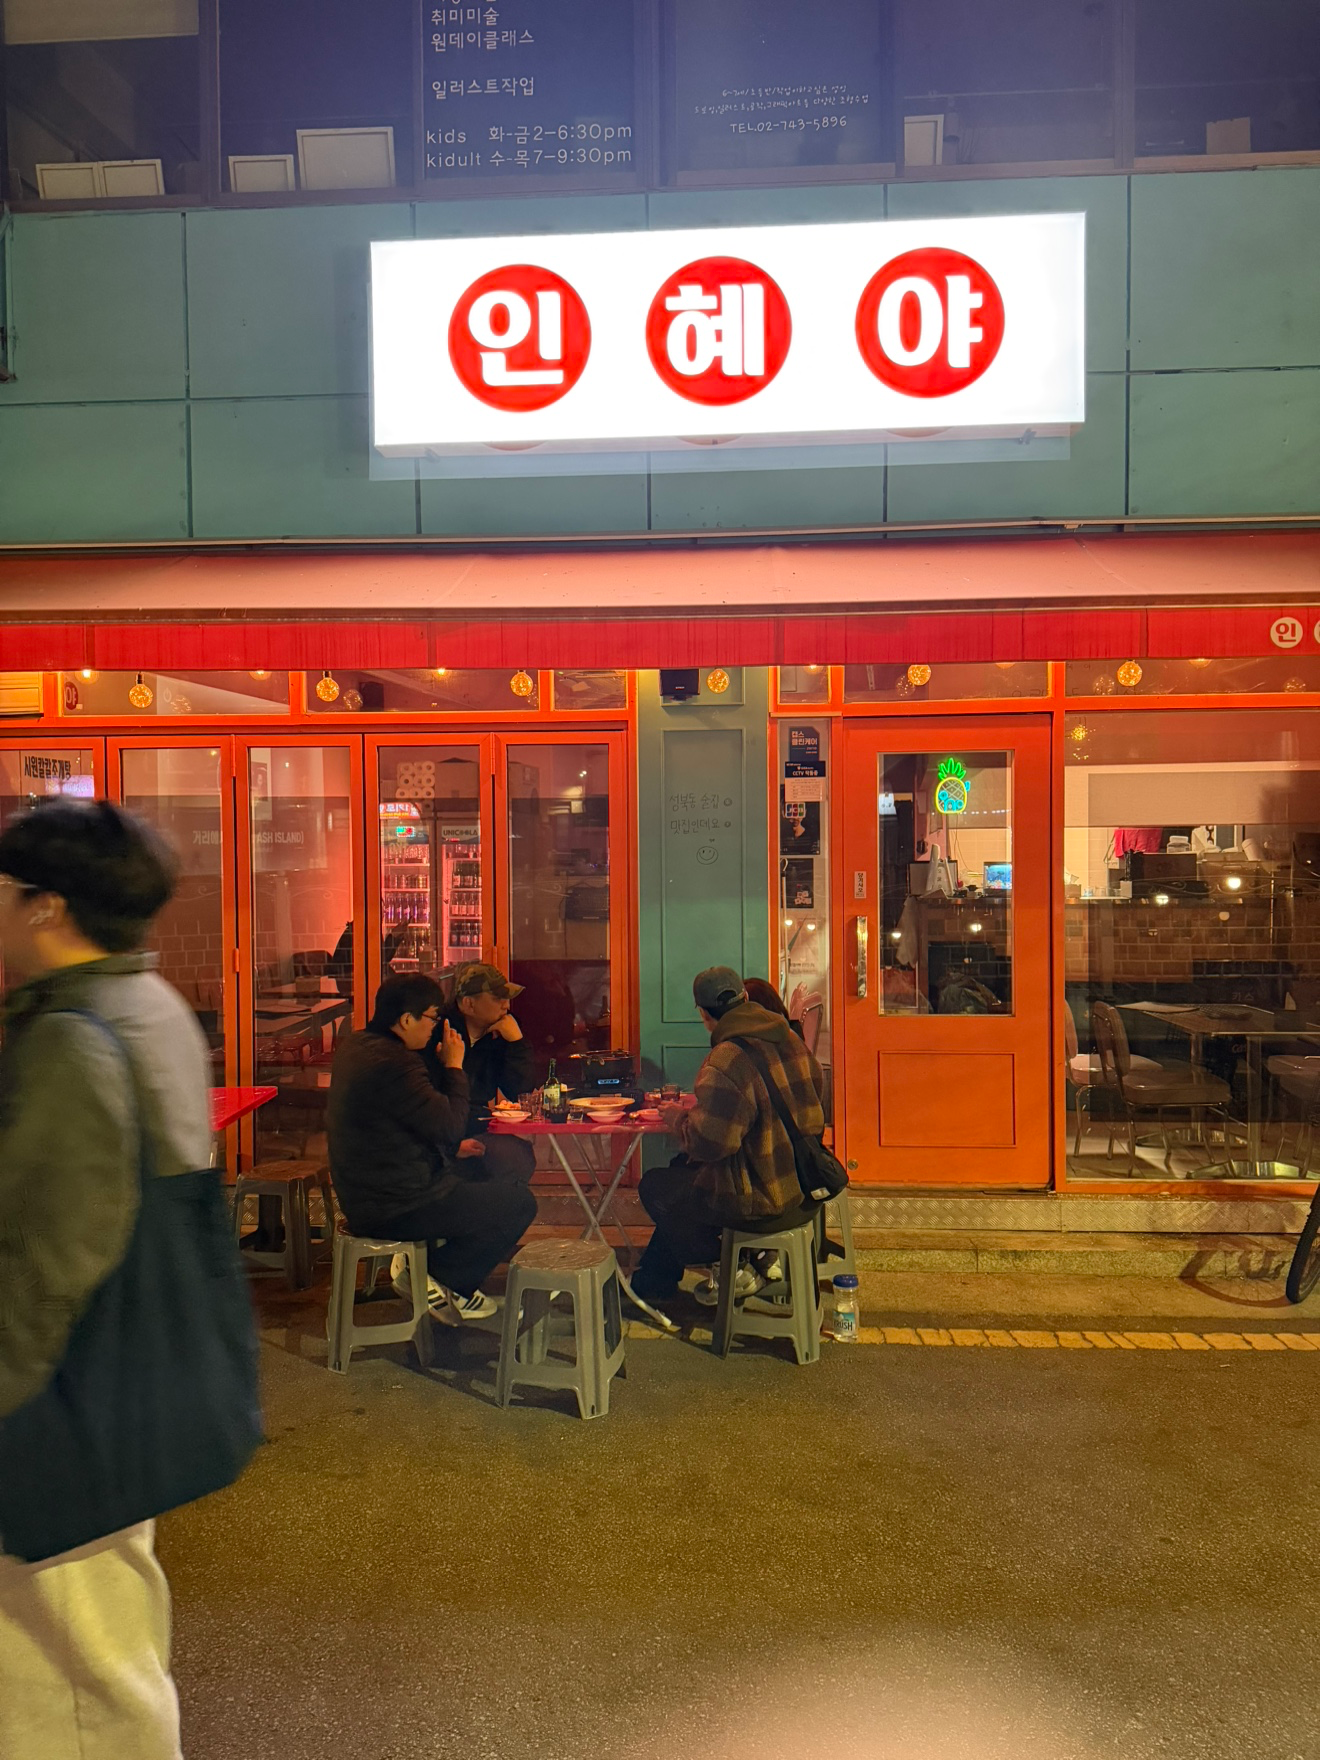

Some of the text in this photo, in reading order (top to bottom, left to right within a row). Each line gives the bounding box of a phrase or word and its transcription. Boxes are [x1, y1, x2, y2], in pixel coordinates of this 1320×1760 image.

[431, 7, 500, 26] 취미미술
[431, 29, 535, 52] 원데이클래스
[432, 76, 535, 100] 일러스트작업
[426, 128, 467, 144] kids
[426, 151, 481, 168] kidult
[669, 792, 697, 812] 성북동
[670, 817, 720, 835] 맛집인데요
